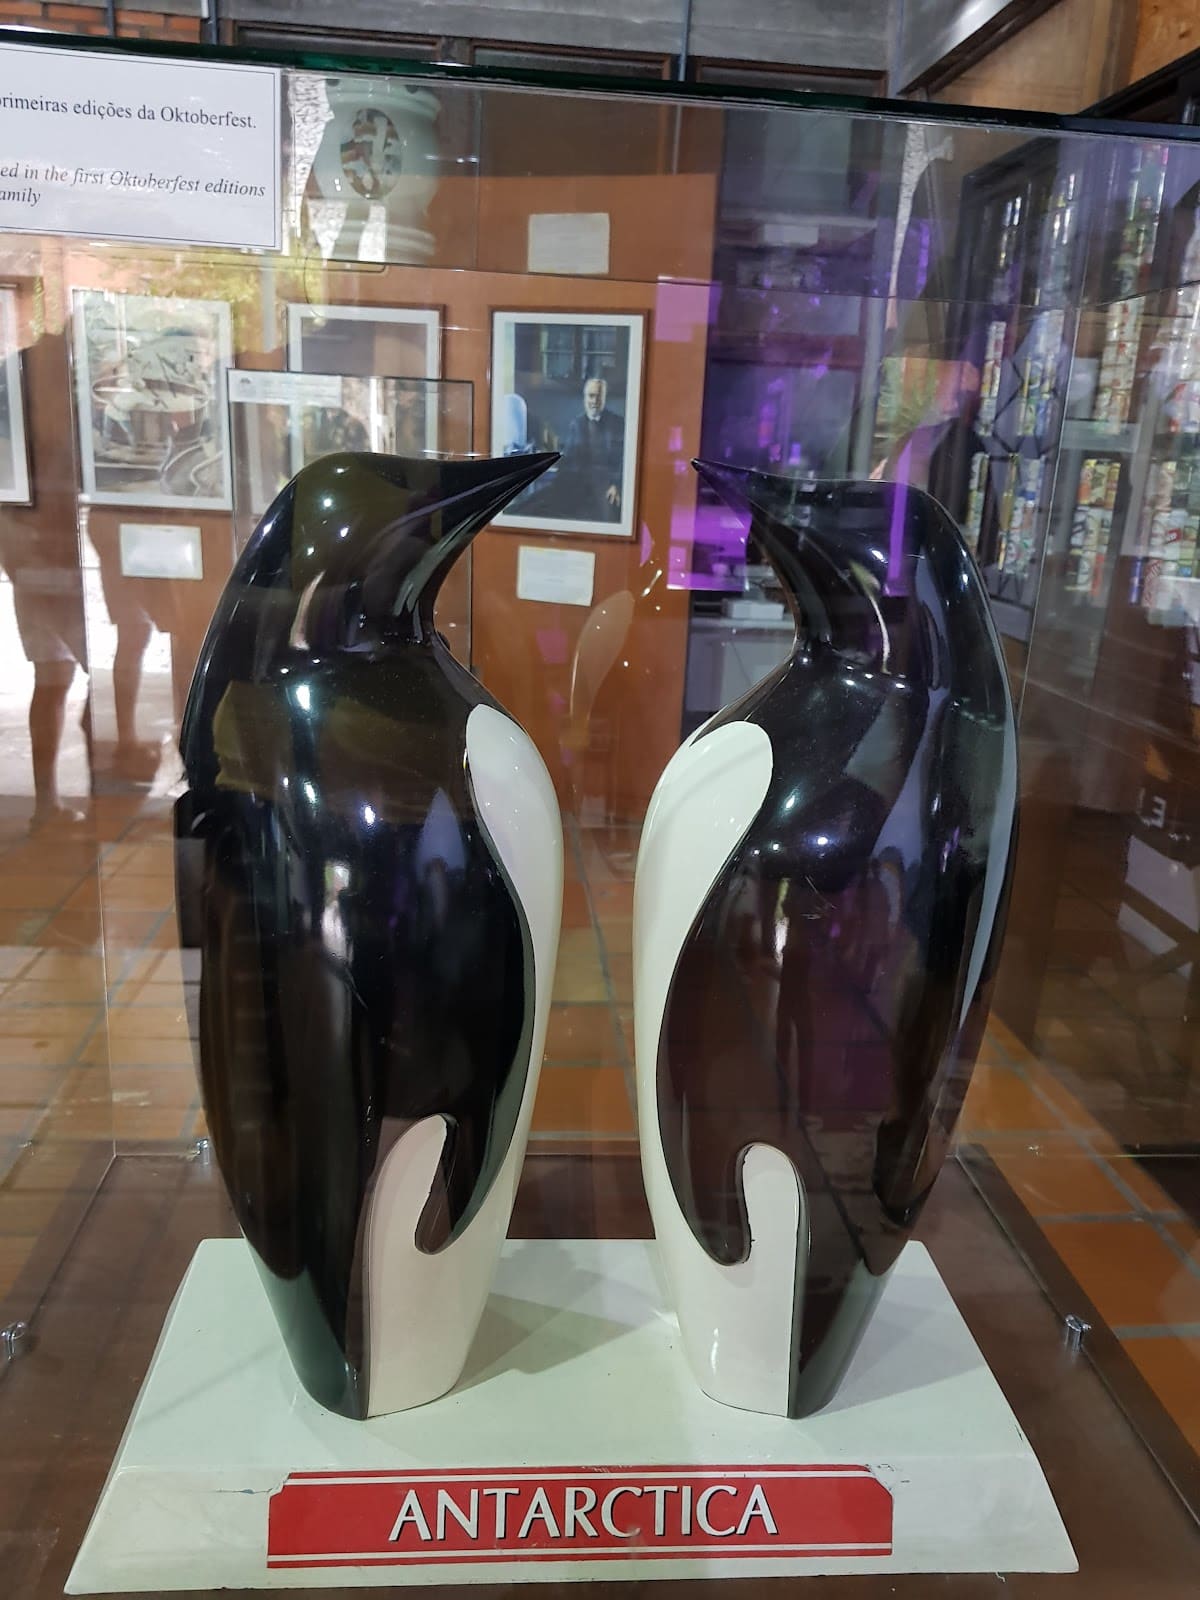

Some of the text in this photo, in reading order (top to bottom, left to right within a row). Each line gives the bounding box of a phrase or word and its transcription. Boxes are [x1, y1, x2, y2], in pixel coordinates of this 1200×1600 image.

[0, 92, 256, 129] rimeiras edições da Oktoberfest.
[24, 164, 38, 179] in
[44, 165, 68, 182] the
[69, 167, 104, 187] first
[110, 170, 200, 194] Oktoberfest
[204, 178, 266, 197] editions
[388, 1484, 779, 1541] ANTARCTICA
